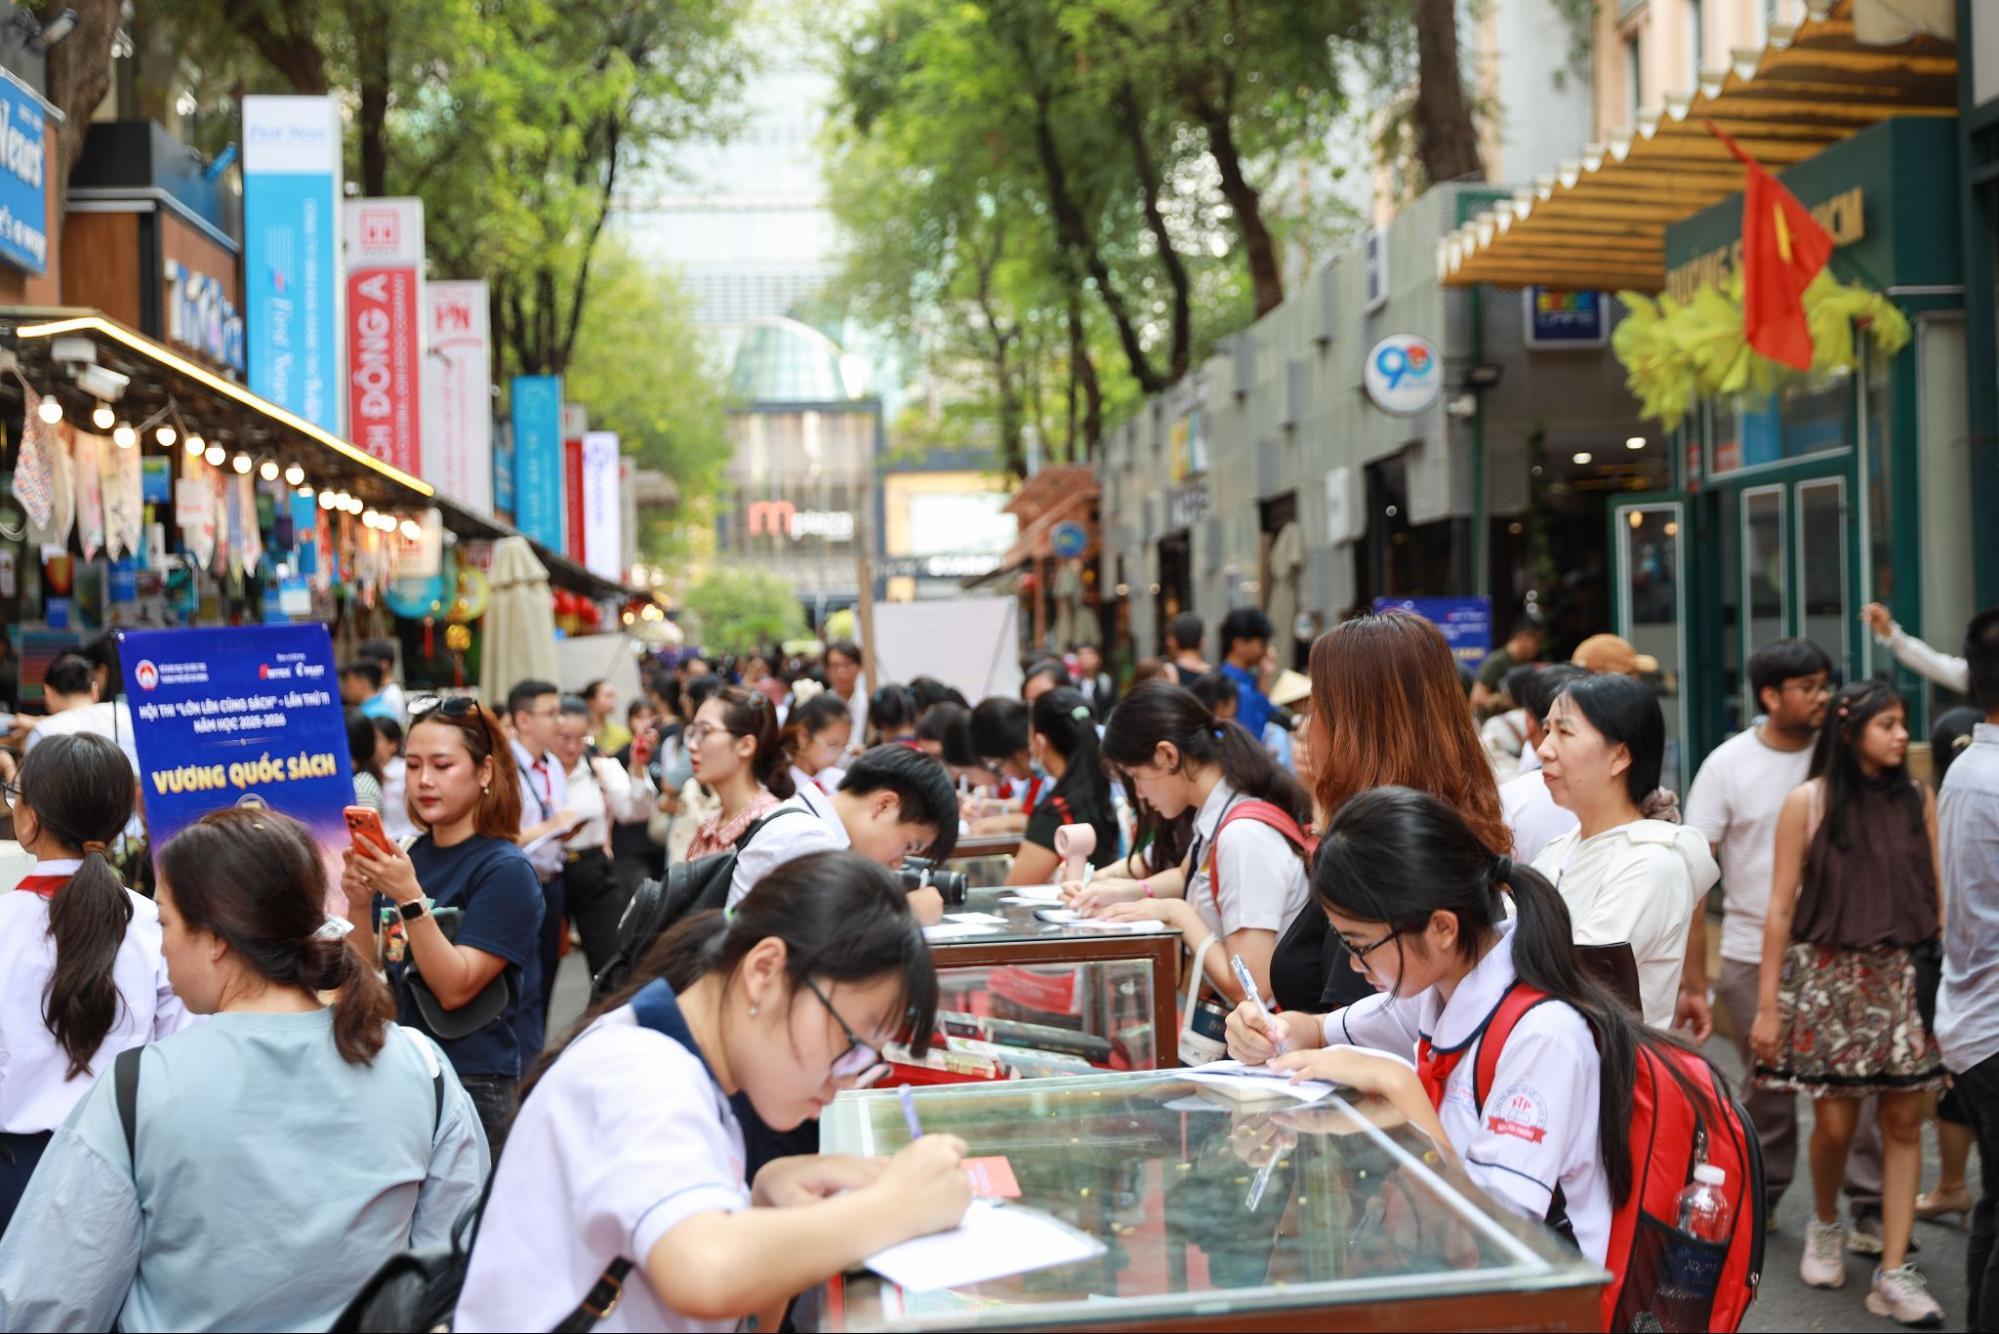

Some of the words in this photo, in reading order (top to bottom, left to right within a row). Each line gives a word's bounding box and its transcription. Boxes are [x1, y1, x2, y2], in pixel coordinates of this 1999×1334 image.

[357, 273, 389, 304] A
[352, 307, 393, 420] ĐÔNG
[152, 764, 227, 794] VƯƠNG
[228, 752, 286, 789] QUỐC
[287, 751, 337, 780] SÁCH
